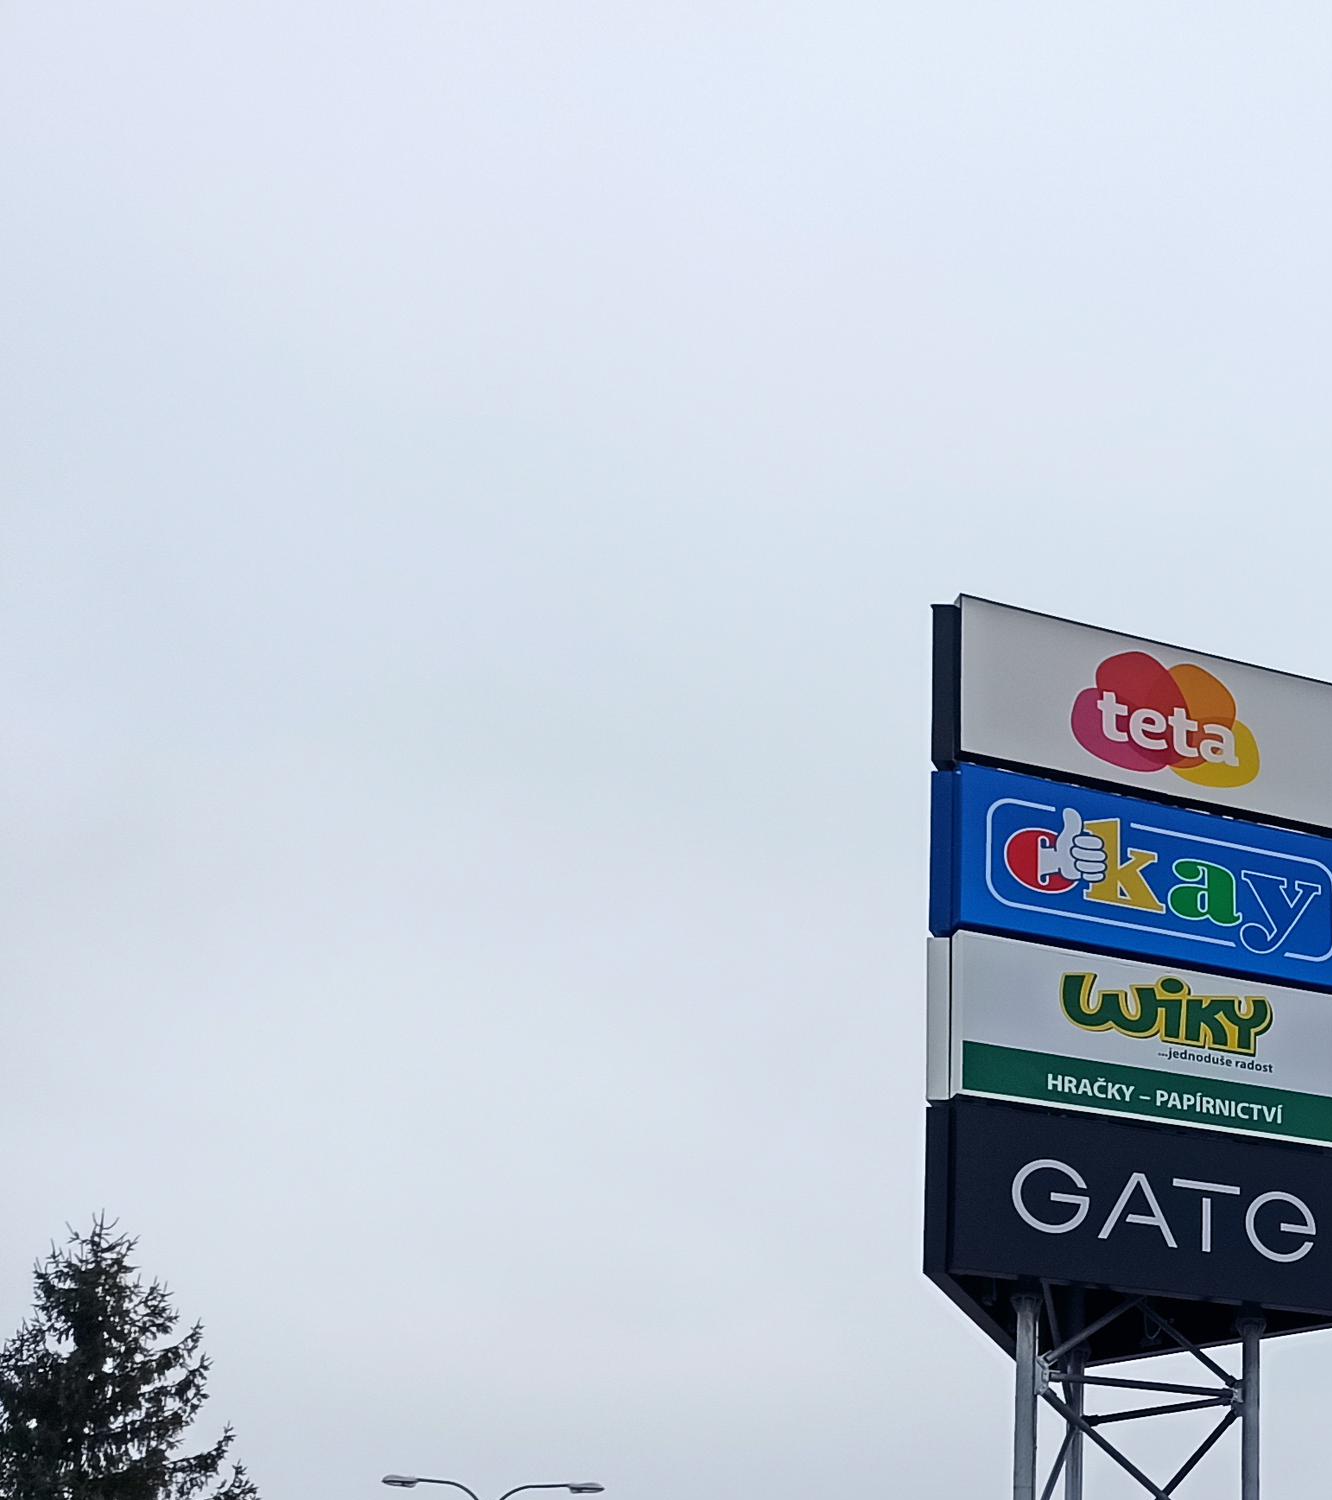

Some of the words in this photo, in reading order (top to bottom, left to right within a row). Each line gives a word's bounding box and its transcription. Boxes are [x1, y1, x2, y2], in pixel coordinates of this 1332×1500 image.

[1097, 691, 1239, 766] teta
[1235, 1057, 1274, 1074] radost
[1047, 1073, 1136, 1102] HRAČKY
[1155, 1089, 1284, 1125] PAPÍRNICTVÍ
